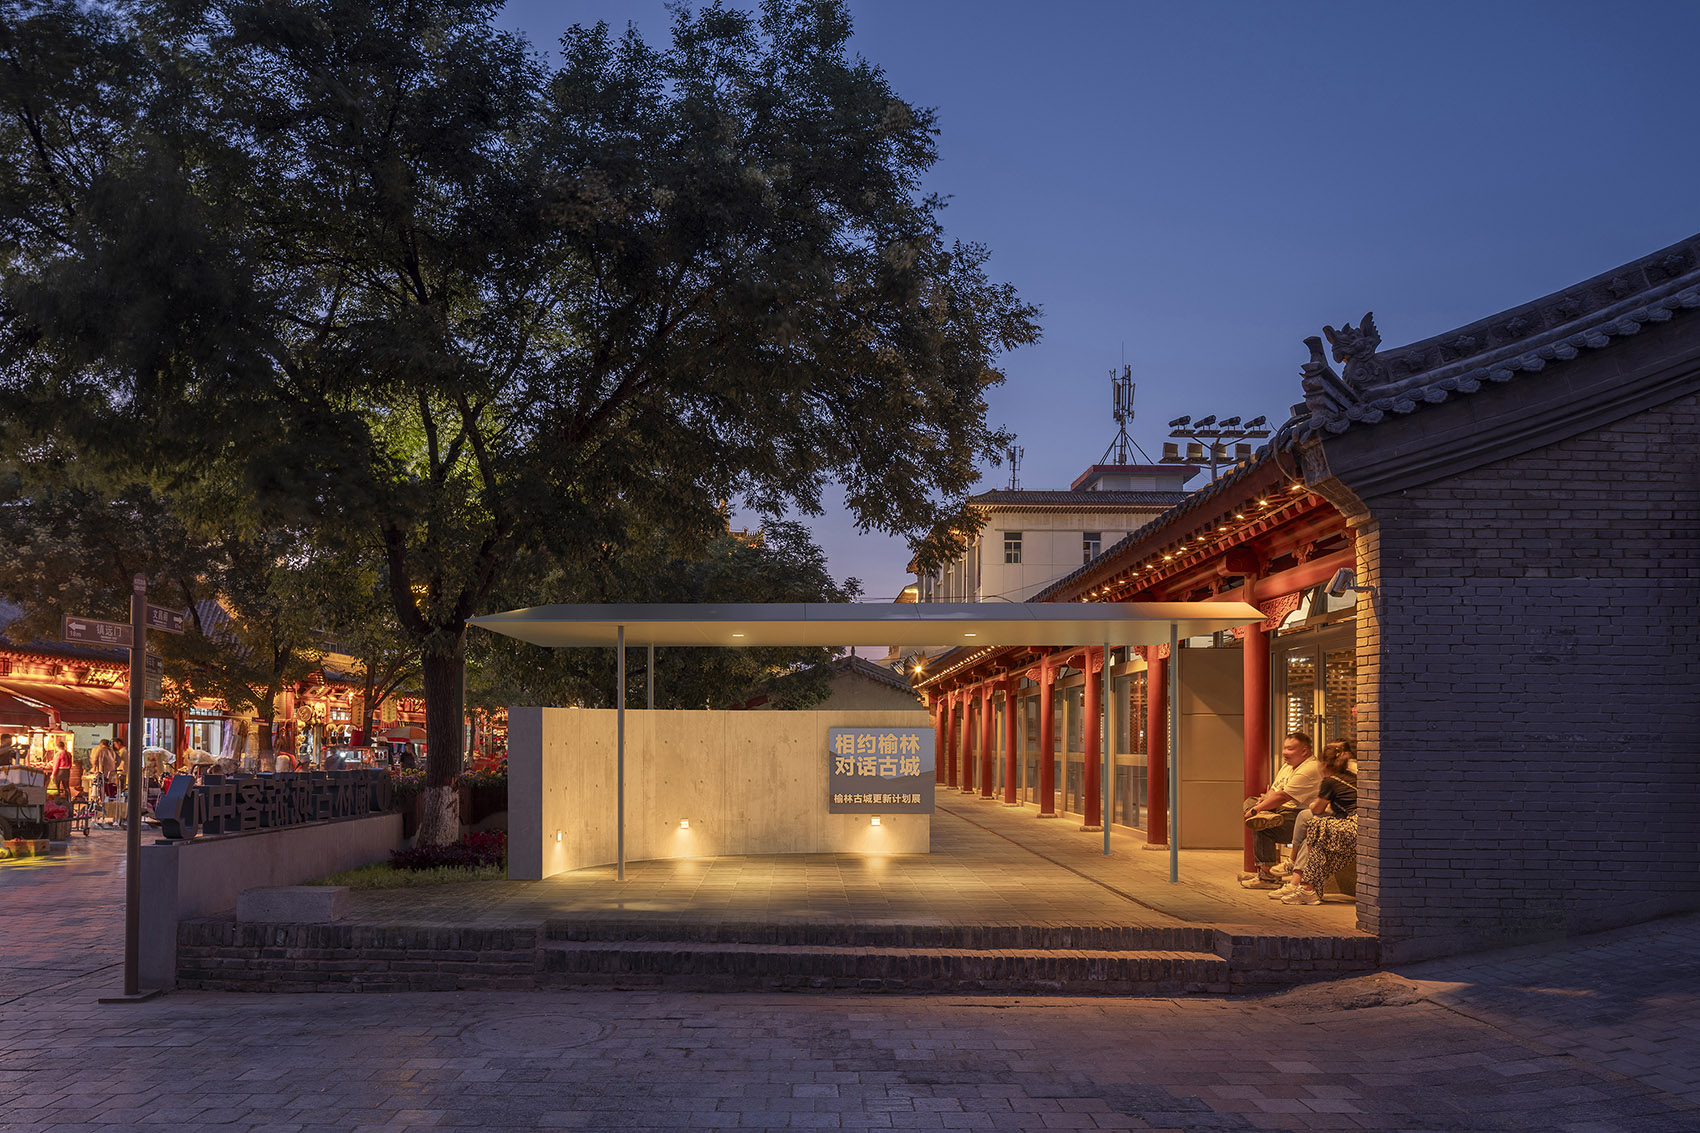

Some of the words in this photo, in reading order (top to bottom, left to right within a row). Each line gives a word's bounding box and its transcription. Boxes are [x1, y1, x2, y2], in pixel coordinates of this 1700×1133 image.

[96, 624, 122, 637] 镇远门
[835, 733, 921, 754] 相约榆林
[835, 756, 921, 777] 对话古城
[834, 793, 921, 804] 榆林古城更新计划展
